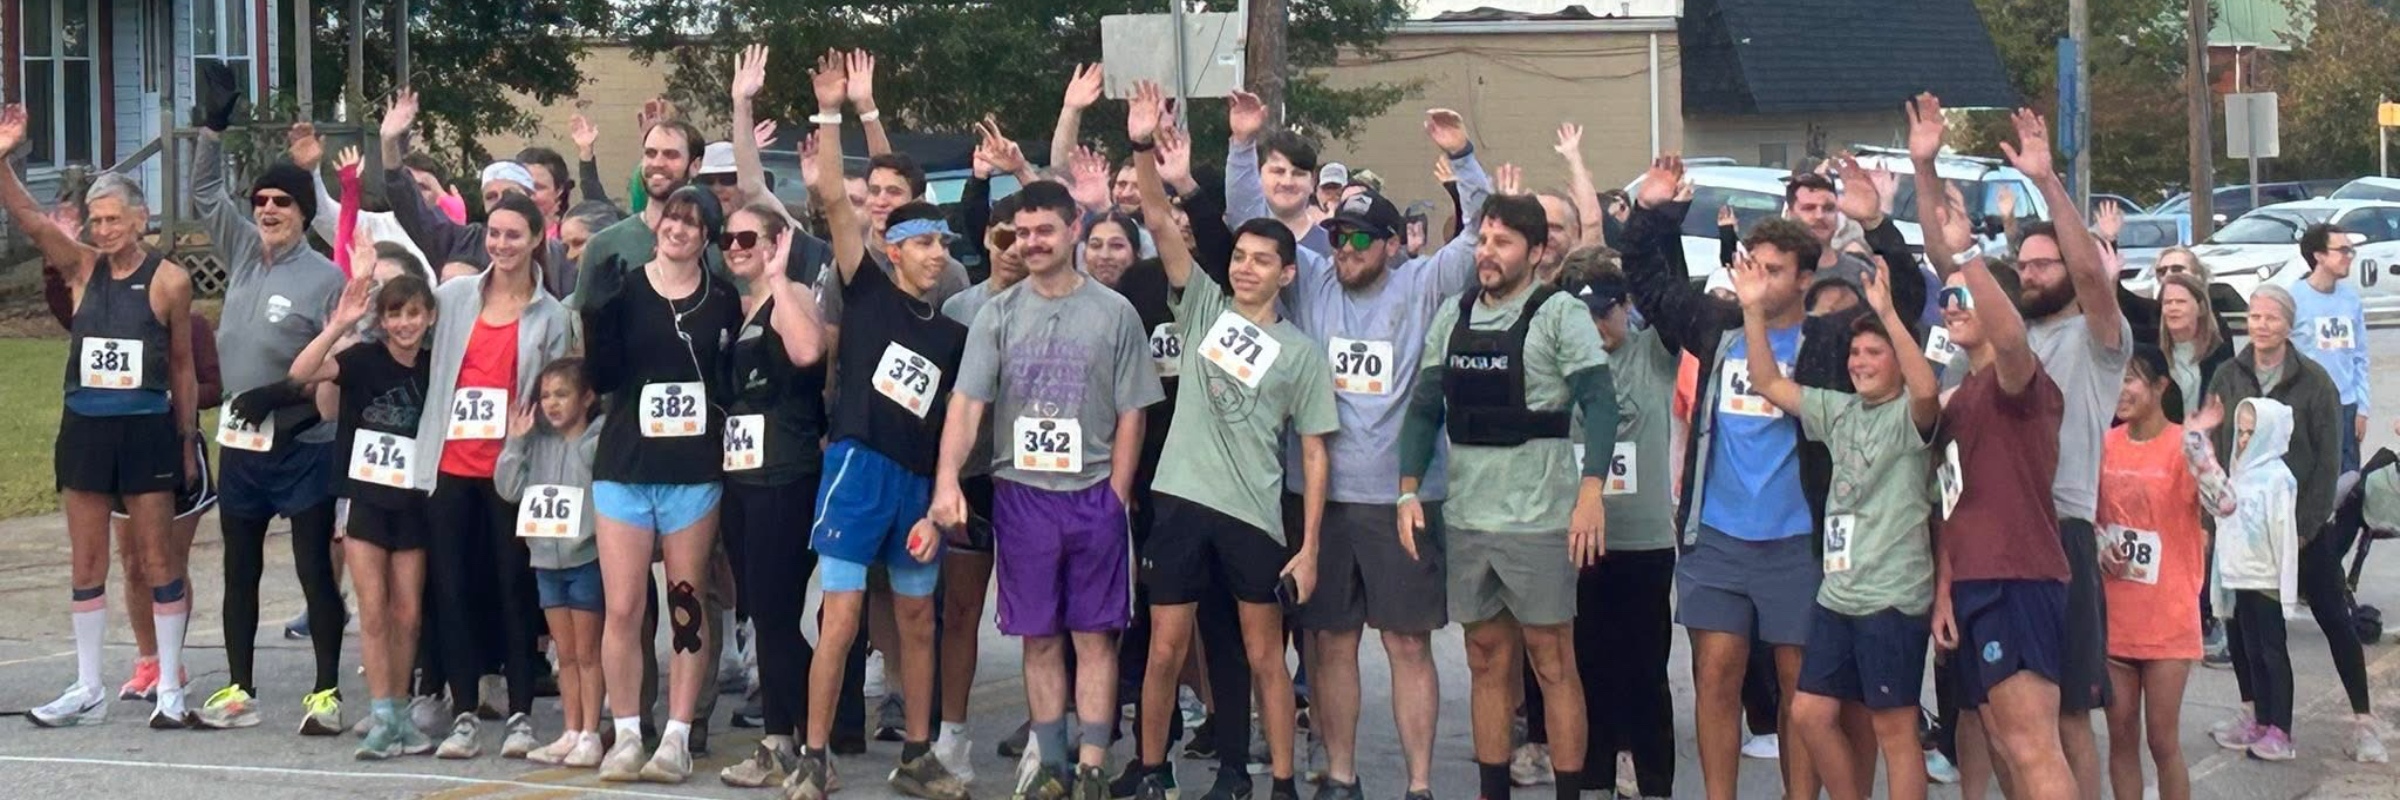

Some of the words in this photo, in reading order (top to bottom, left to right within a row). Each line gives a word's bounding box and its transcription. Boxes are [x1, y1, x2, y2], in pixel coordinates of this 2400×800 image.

[1152, 336, 1180, 358] 38
[1219, 326, 1262, 365] 371
[91, 350, 131, 371] 381
[1335, 351, 1382, 376] 370
[889, 357, 930, 395] 373
[454, 399, 494, 421] 413
[650, 395, 696, 418] 382
[1025, 430, 1070, 453] 342
[364, 443, 405, 469] 414
[529, 496, 570, 519] 416
